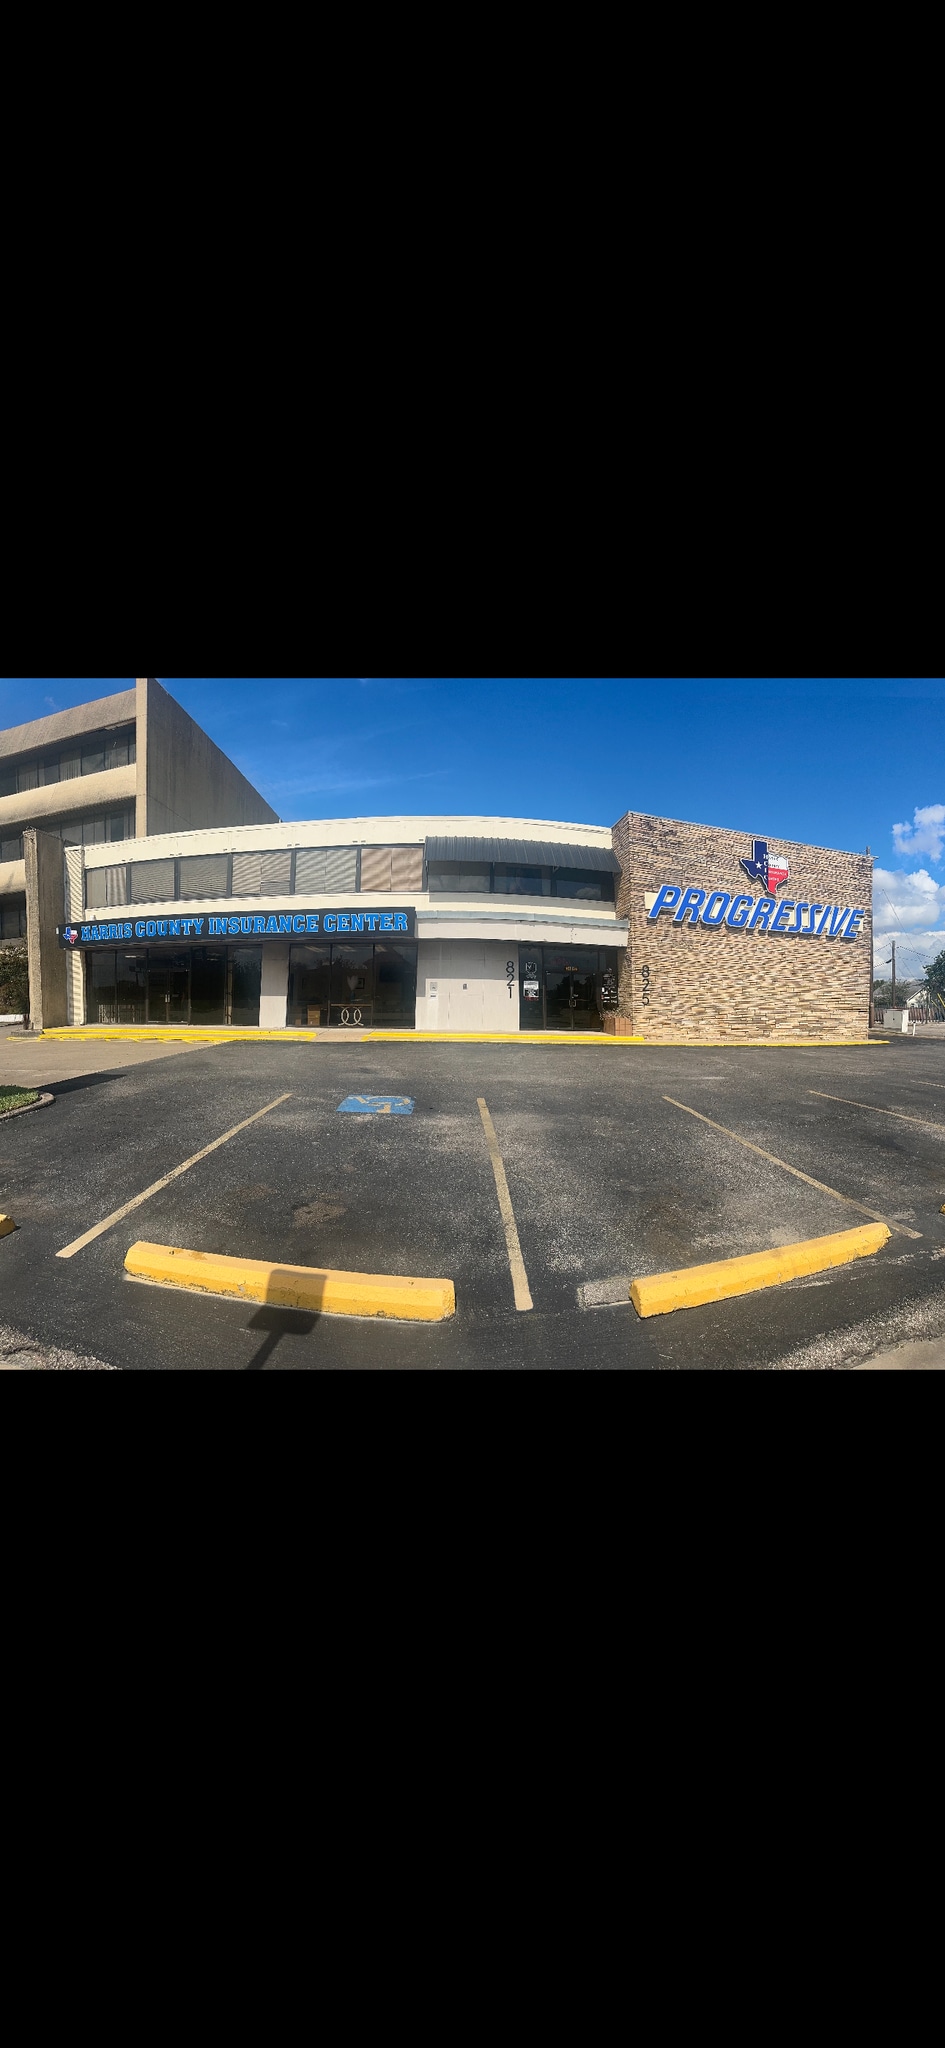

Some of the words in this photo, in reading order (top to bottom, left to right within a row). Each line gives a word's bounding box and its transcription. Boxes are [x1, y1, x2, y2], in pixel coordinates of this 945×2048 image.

[81, 923, 133, 942] HARRIS
[135, 917, 205, 938] COUNTY
[208, 914, 320, 934] INSURANCE
[323, 912, 409, 932] CENTER
[648, 884, 865, 938] PROGRESSIVE
[505, 960, 515, 999] 821
[641, 964, 650, 1006] 825
